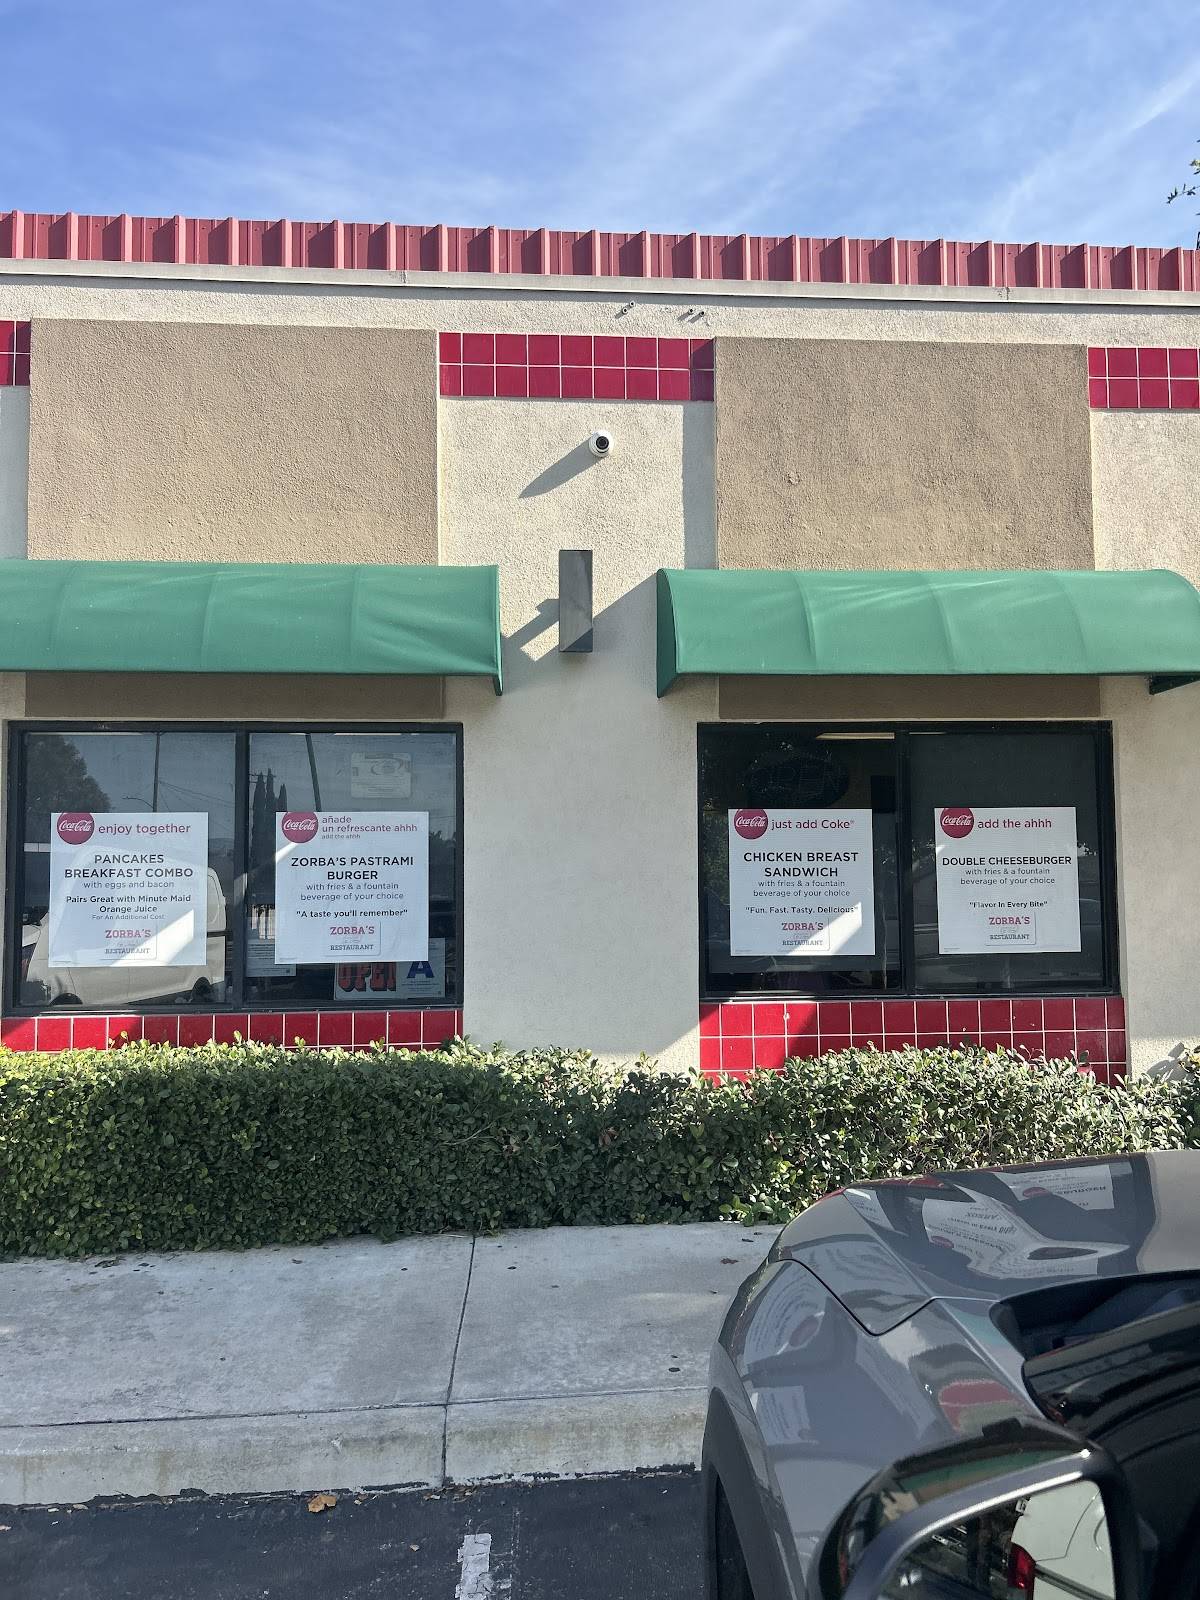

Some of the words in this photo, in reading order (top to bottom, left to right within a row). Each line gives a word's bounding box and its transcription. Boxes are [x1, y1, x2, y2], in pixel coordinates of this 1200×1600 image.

[284, 819, 316, 830] Coca-Cola
[736, 816, 767, 827] Coca-Cola
[942, 815, 972, 825] Coca-Cola
[978, 819, 998, 828] add
[1003, 819, 1020, 828] the
[1025, 819, 1051, 827] ahhh
[59, 820, 93, 831] Coca-Cola
[99, 824, 132, 834] enjoy
[137, 824, 191, 834] together
[771, 820, 792, 830] just
[796, 820, 817, 828] add
[95, 855, 164, 863] PANCAKES
[292, 857, 346, 866] ZORBA'S
[351, 857, 413, 865] PASTRAMI
[744, 853, 802, 861] CHICKEN
[807, 853, 858, 861] BREAST
[989, 857, 1071, 865] CHEESEBURGER
[65, 869, 141, 877] BREAKFAST
[146, 869, 193, 877] COMBO
[328, 871, 378, 880] BURGER
[765, 868, 838, 876] SANDWICH
[106, 929, 151, 938] ZORBA'S
[330, 926, 374, 934] ZORBA'S
